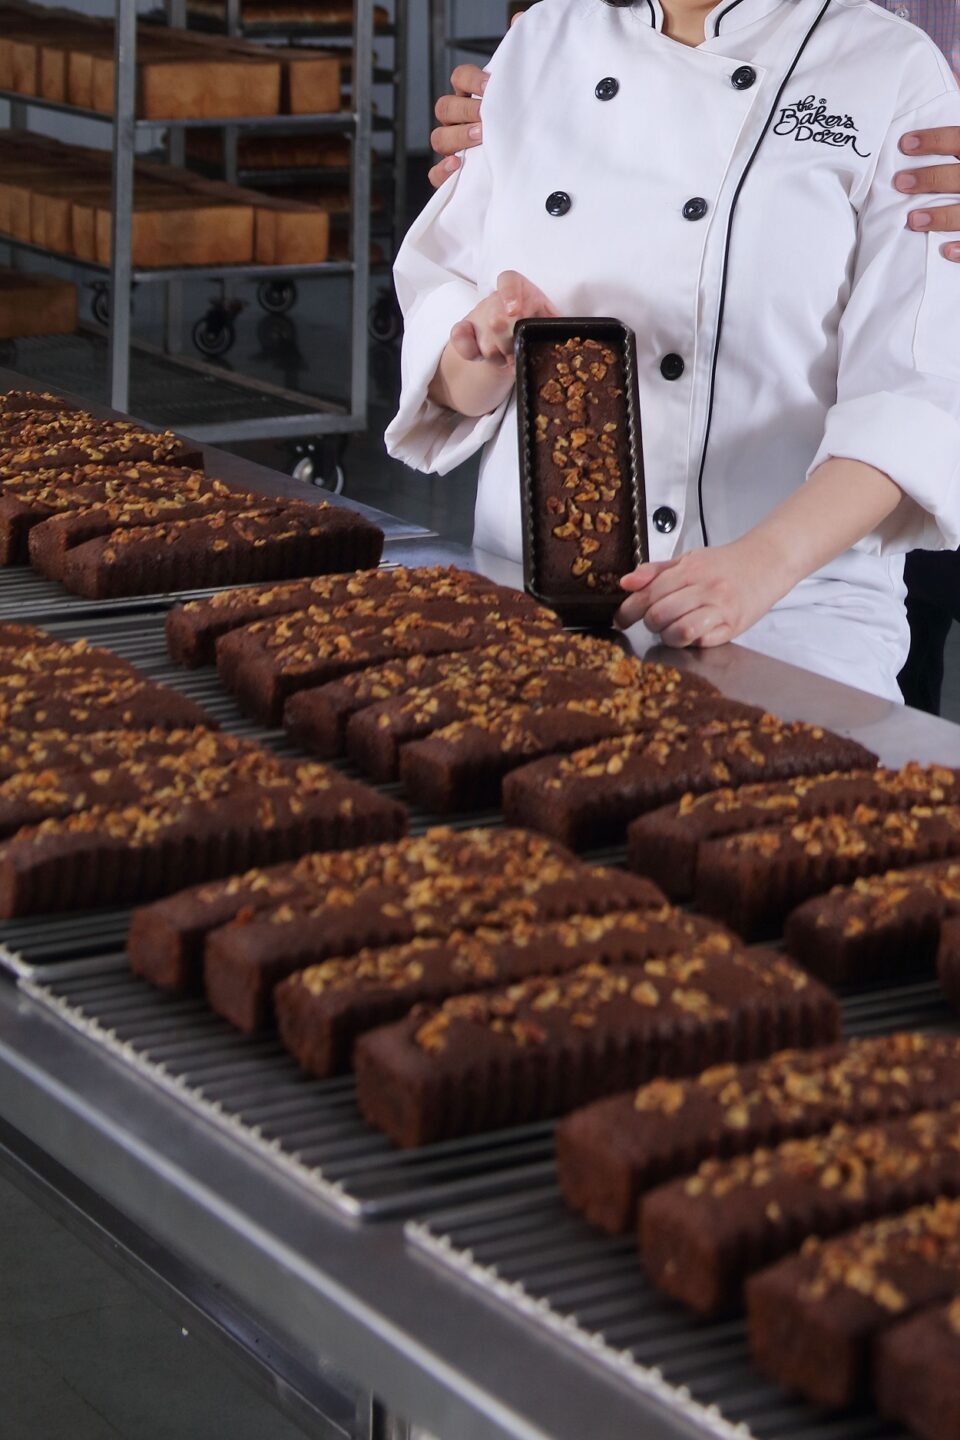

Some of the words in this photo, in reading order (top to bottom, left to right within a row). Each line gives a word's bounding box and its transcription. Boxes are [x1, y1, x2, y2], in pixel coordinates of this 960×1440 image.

[788, 95, 817, 112] the
[773, 105, 859, 135] Baker's
[794, 125, 871, 157] Dozen
